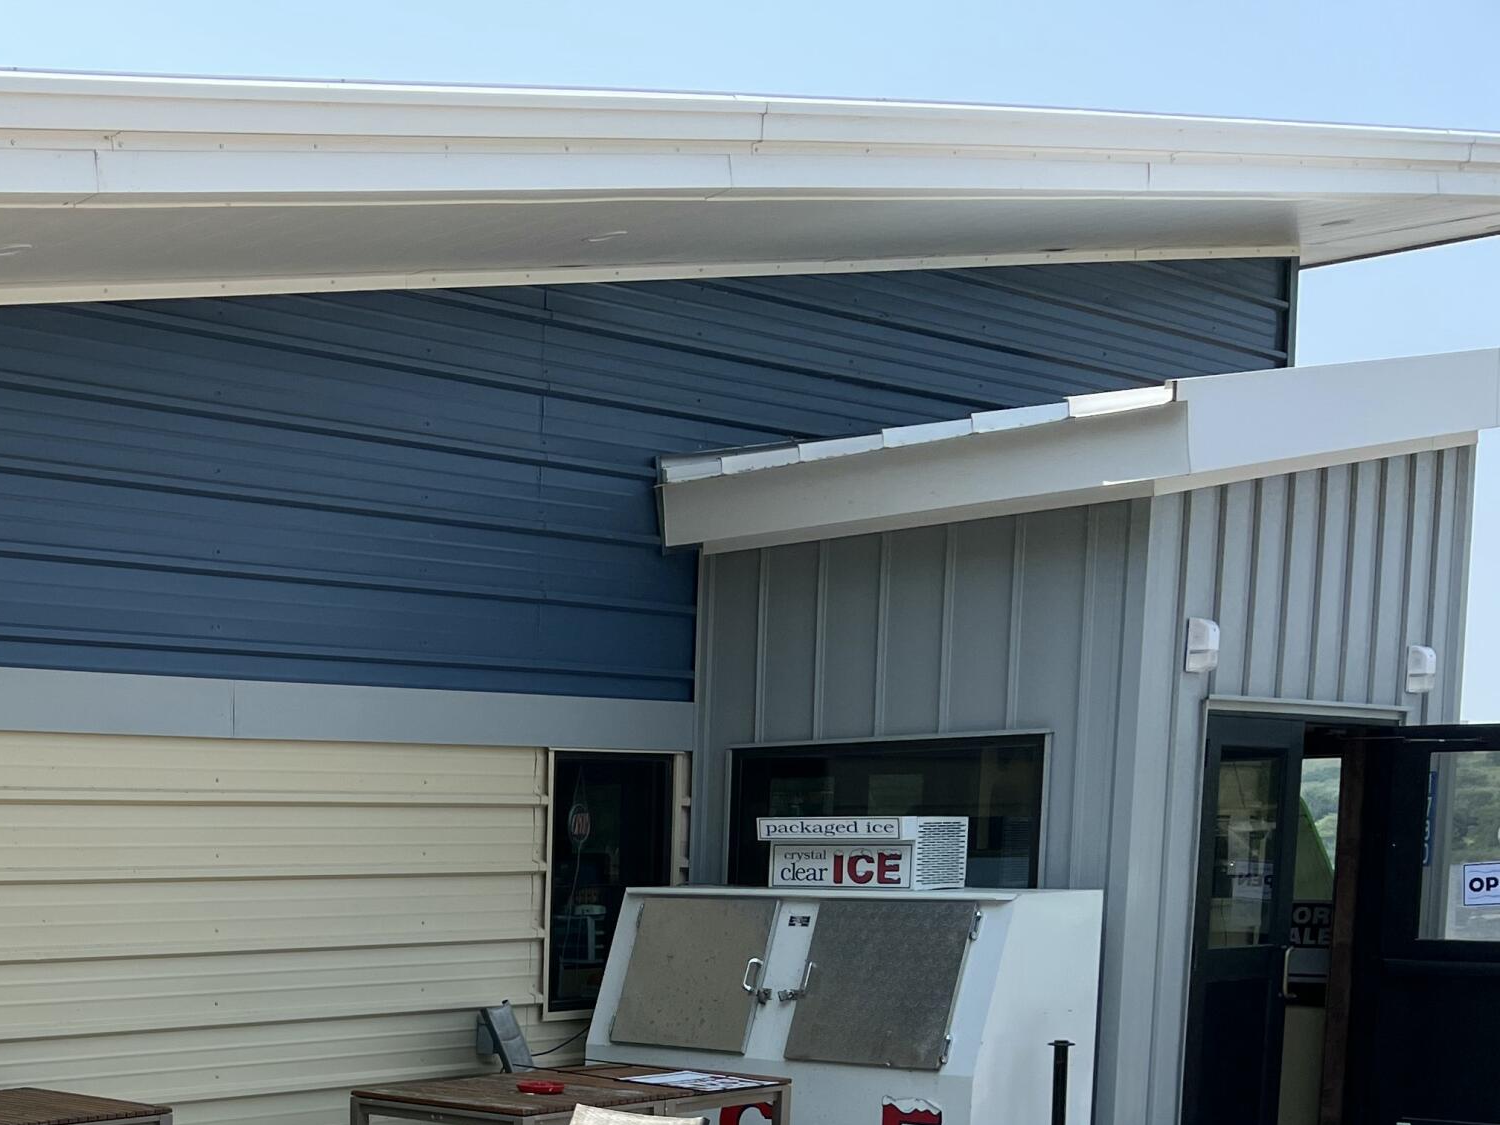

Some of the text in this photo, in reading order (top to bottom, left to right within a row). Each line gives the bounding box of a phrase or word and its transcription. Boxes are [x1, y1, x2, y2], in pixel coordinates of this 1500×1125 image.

[765, 820, 894, 836] packaged ice
[784, 850, 827, 863] crystal
[780, 848, 902, 884] clear ICE
[1292, 906, 1332, 925] OR
[1289, 927, 1331, 944] ALE
